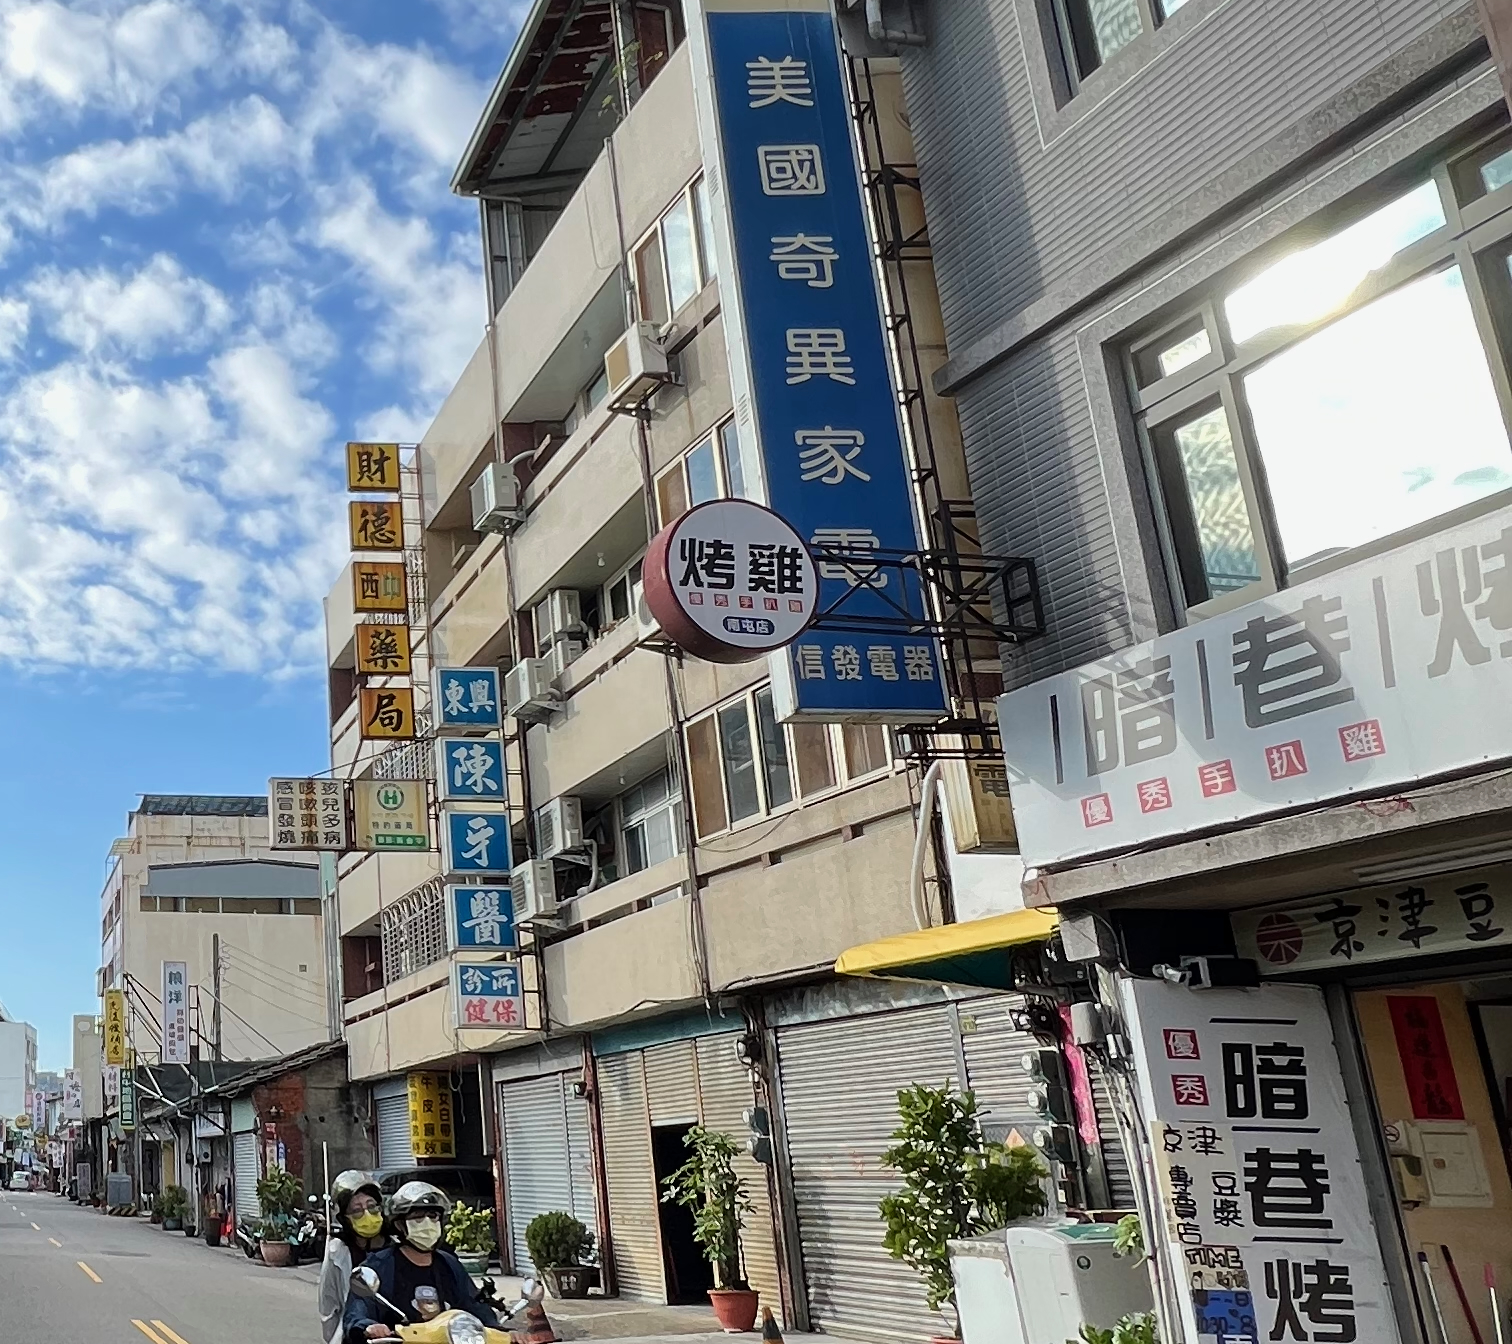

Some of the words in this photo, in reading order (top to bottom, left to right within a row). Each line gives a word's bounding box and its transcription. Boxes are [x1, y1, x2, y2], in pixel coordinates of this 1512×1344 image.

[745, 55, 888, 590] 美國奇異家電
[679, 537, 804, 595] 烤雞
[726, 617, 770, 634] 南屯店
[795, 644, 935, 682] 信發電器
[1082, 720, 1386, 828] 優秀手扒雞
[1314, 882, 1505, 960] 京津豆
[461, 967, 516, 996] 診所
[464, 998, 519, 1025] 健保
[1165, 1029, 1209, 1106] 優秀
[1185, 1247, 1244, 1270] TIME
